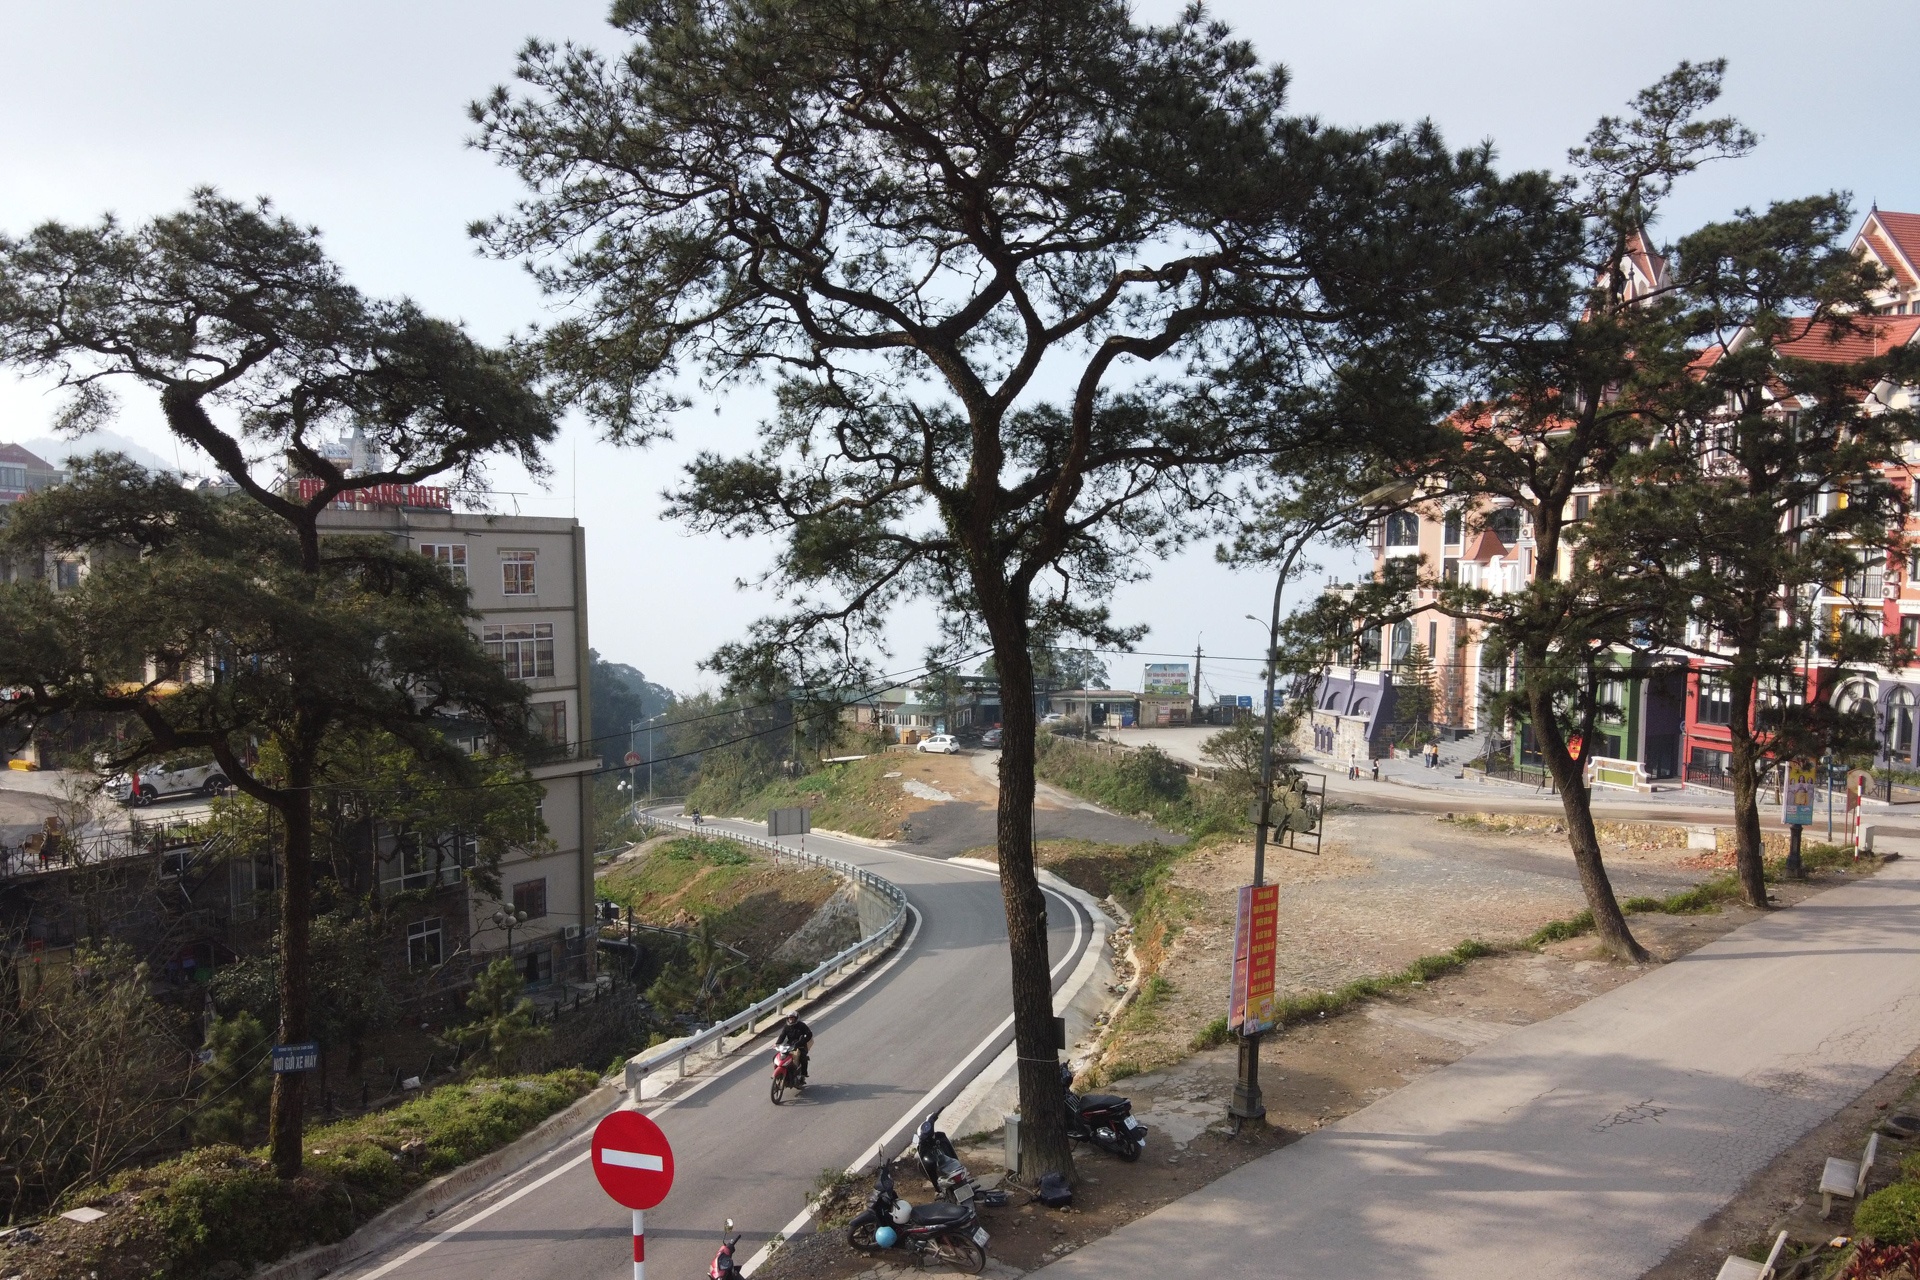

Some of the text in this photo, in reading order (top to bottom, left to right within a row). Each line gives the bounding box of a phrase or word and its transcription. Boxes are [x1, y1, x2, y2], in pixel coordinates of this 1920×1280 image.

[361, 482, 404, 505] SANG
[408, 485, 451, 510] HOTEL
[273, 1051, 318, 1071] NƠI GỬI XE MÁY
